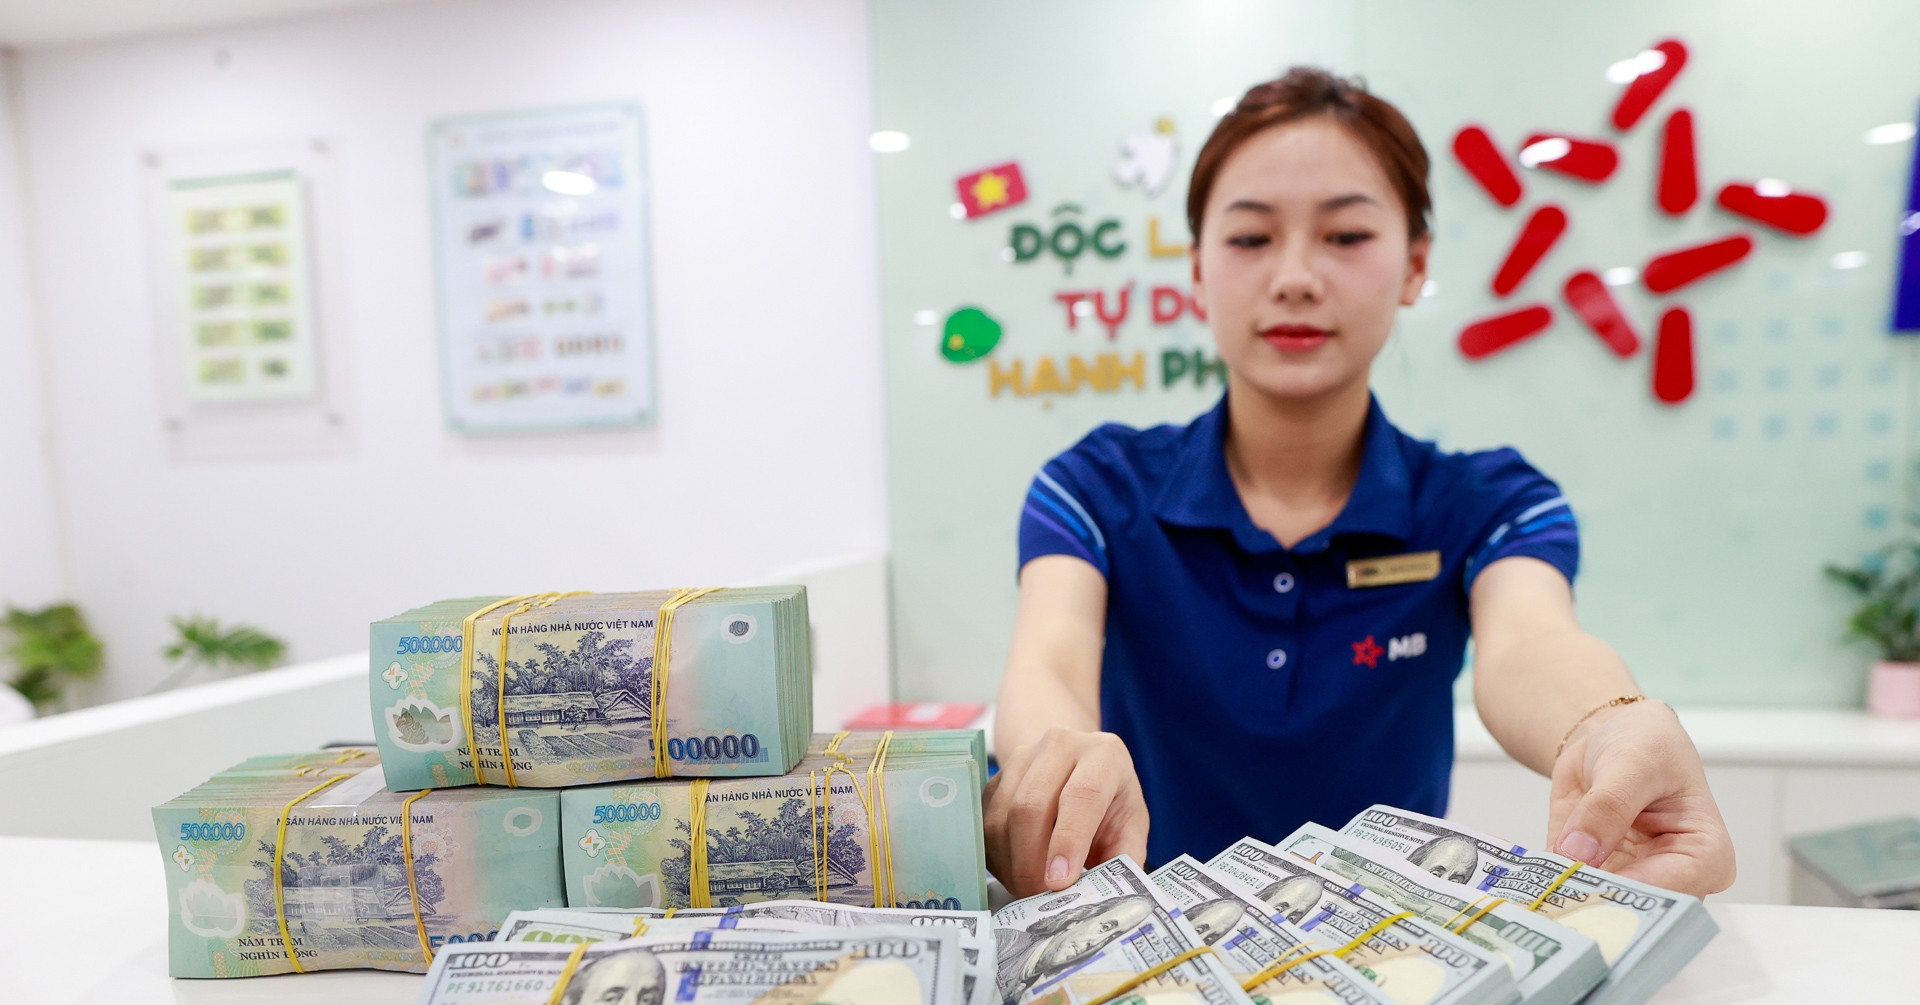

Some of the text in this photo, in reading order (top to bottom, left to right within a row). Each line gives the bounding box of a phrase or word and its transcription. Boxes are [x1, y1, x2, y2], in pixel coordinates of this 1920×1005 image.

[1010, 204, 1187, 275] ĐỘC L
[1055, 279, 1136, 340] TỰ
[988, 350, 1229, 410] HẠNH PH
[520, 621, 548, 634] HÀNG
[550, 620, 572, 632] NHÀ
[574, 618, 604, 631] NƯỚC
[605, 618, 629, 632] VIỆT
[631, 619, 654, 629] NAM
[1387, 632, 1427, 662] MB
[486, 747, 520, 757] TRM
[705, 786, 853, 803] ÂN HÀNG NHÀ NƯỚC VỆT NAM
[307, 815, 337, 826] HÀNG
[339, 815, 359, 826] NHÀ
[362, 815, 388, 825] NƯỚC
[390, 814, 410, 827] VIỆ
[412, 815, 434, 824] NAM
[1363, 811, 1399, 828] 100
[1409, 836, 1426, 845] NOTE
[1233, 845, 1265, 862] 100
[1105, 861, 1127, 877] 100
[1171, 863, 1199, 880] 100
[1528, 872, 1590, 902] STTES
[1600, 886, 1658, 912] 100
[238, 936, 304, 947] NĂM TRM
[240, 950, 280, 961] NGHÌN
[448, 952, 511, 970] 100
[1419, 938, 1470, 968] 100
